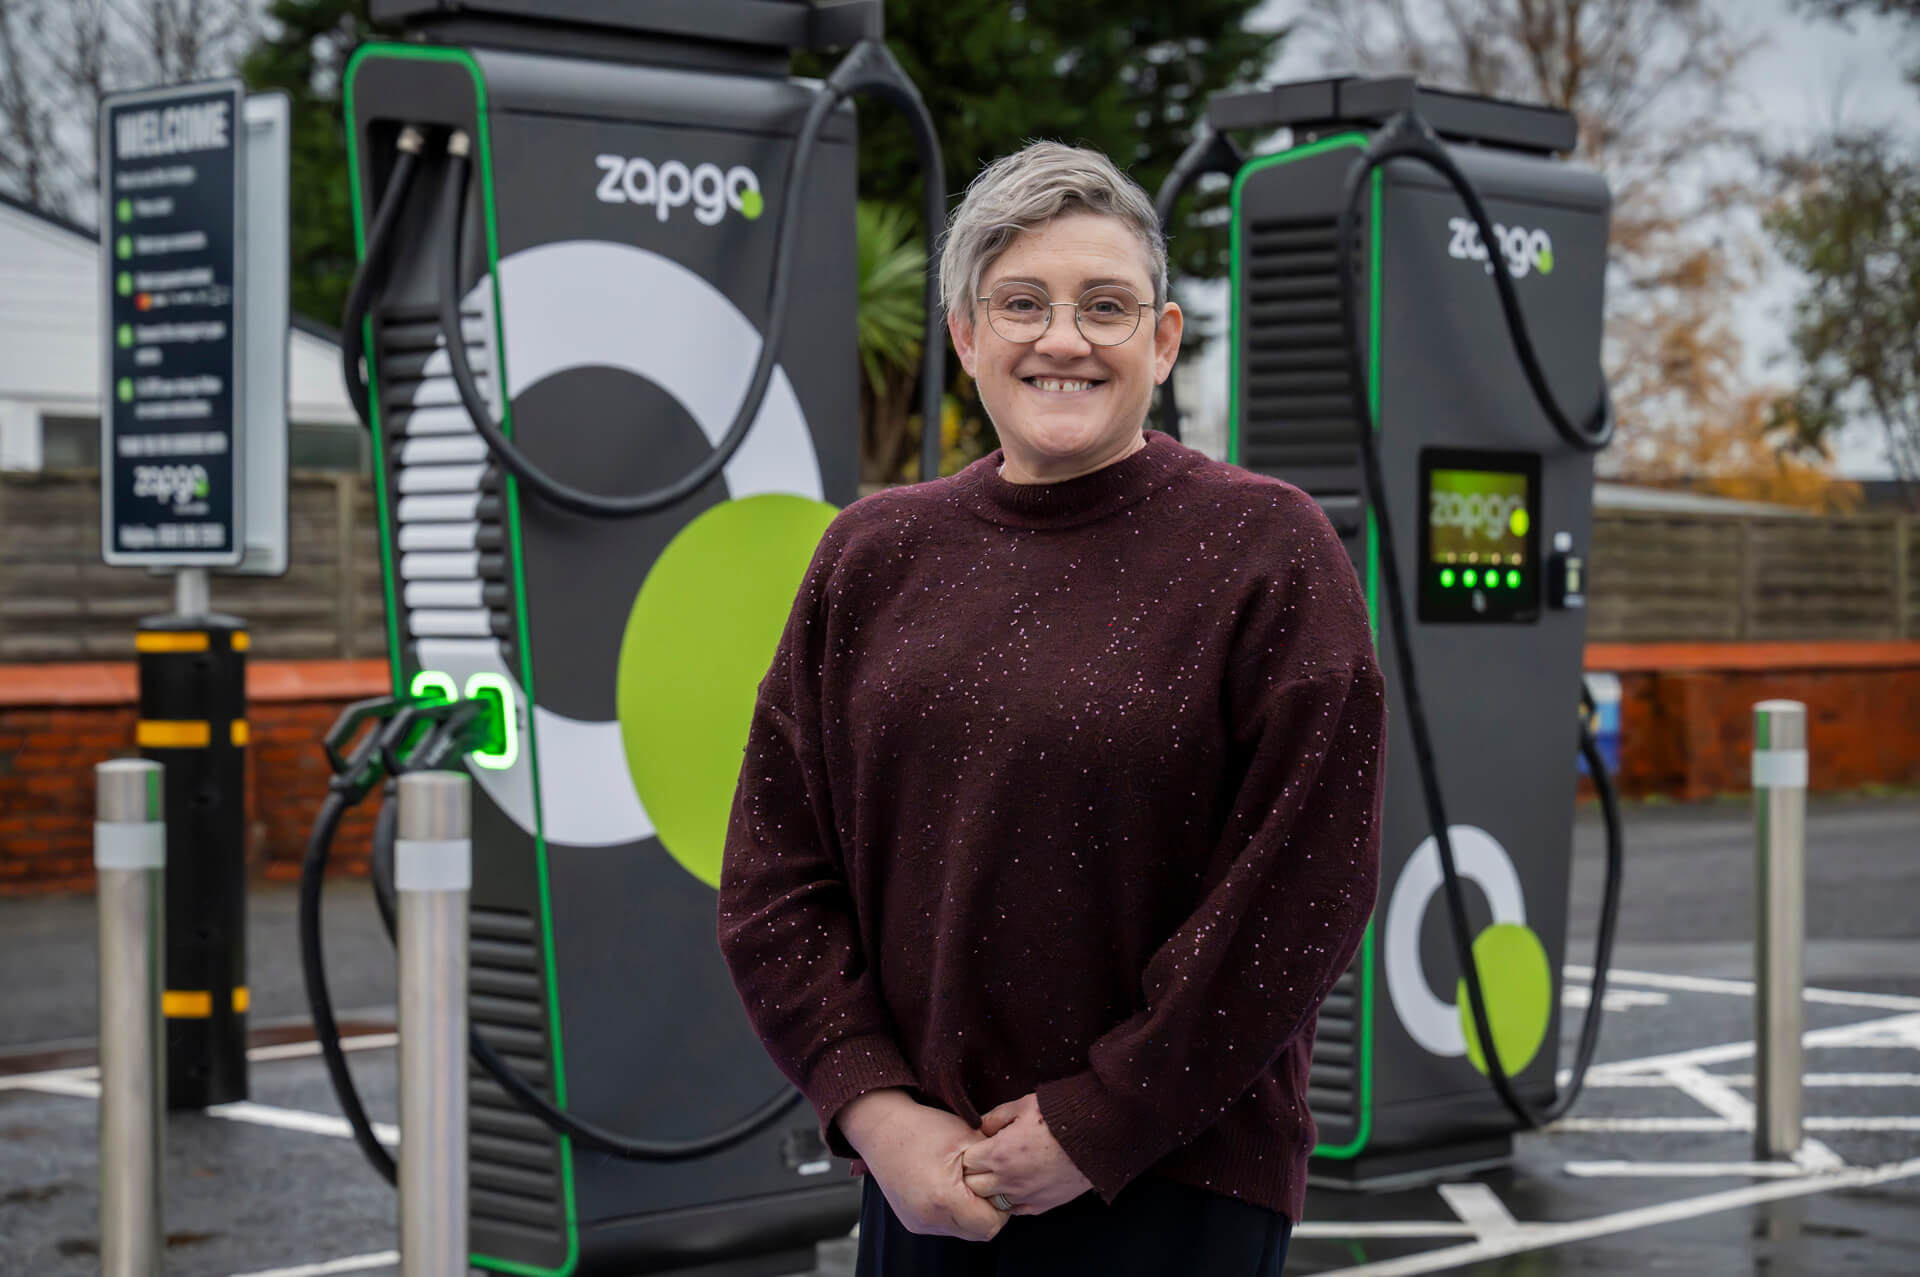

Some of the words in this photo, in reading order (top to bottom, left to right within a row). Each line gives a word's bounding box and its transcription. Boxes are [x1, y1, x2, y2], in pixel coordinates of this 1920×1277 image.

[116, 102, 228, 159] WELCOME
[595, 154, 763, 226] zapgo
[134, 465, 209, 504] zapgo
[1430, 491, 1529, 540] zapgo
